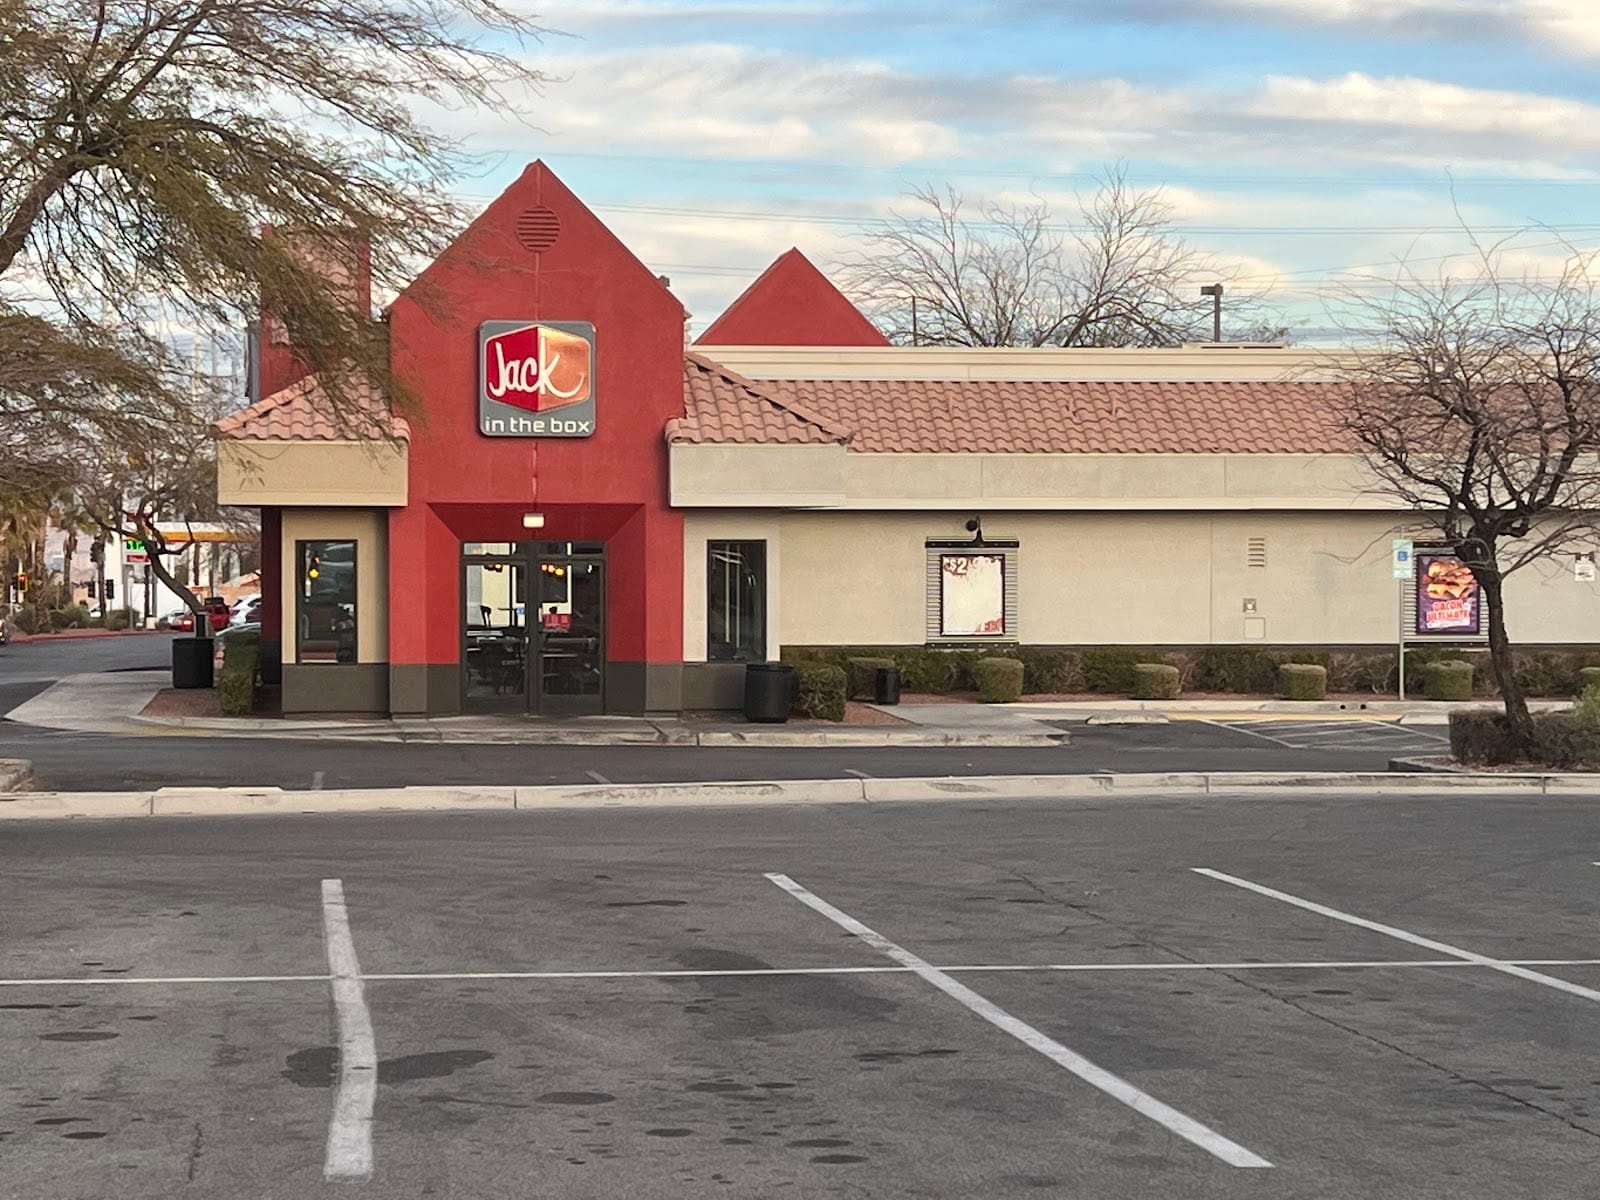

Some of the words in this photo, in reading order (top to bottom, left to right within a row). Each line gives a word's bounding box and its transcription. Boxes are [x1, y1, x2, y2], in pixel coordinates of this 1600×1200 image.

[488, 336, 585, 398] Jack
[485, 416, 505, 432] in
[510, 417, 545, 433] the
[550, 417, 590, 433] box
